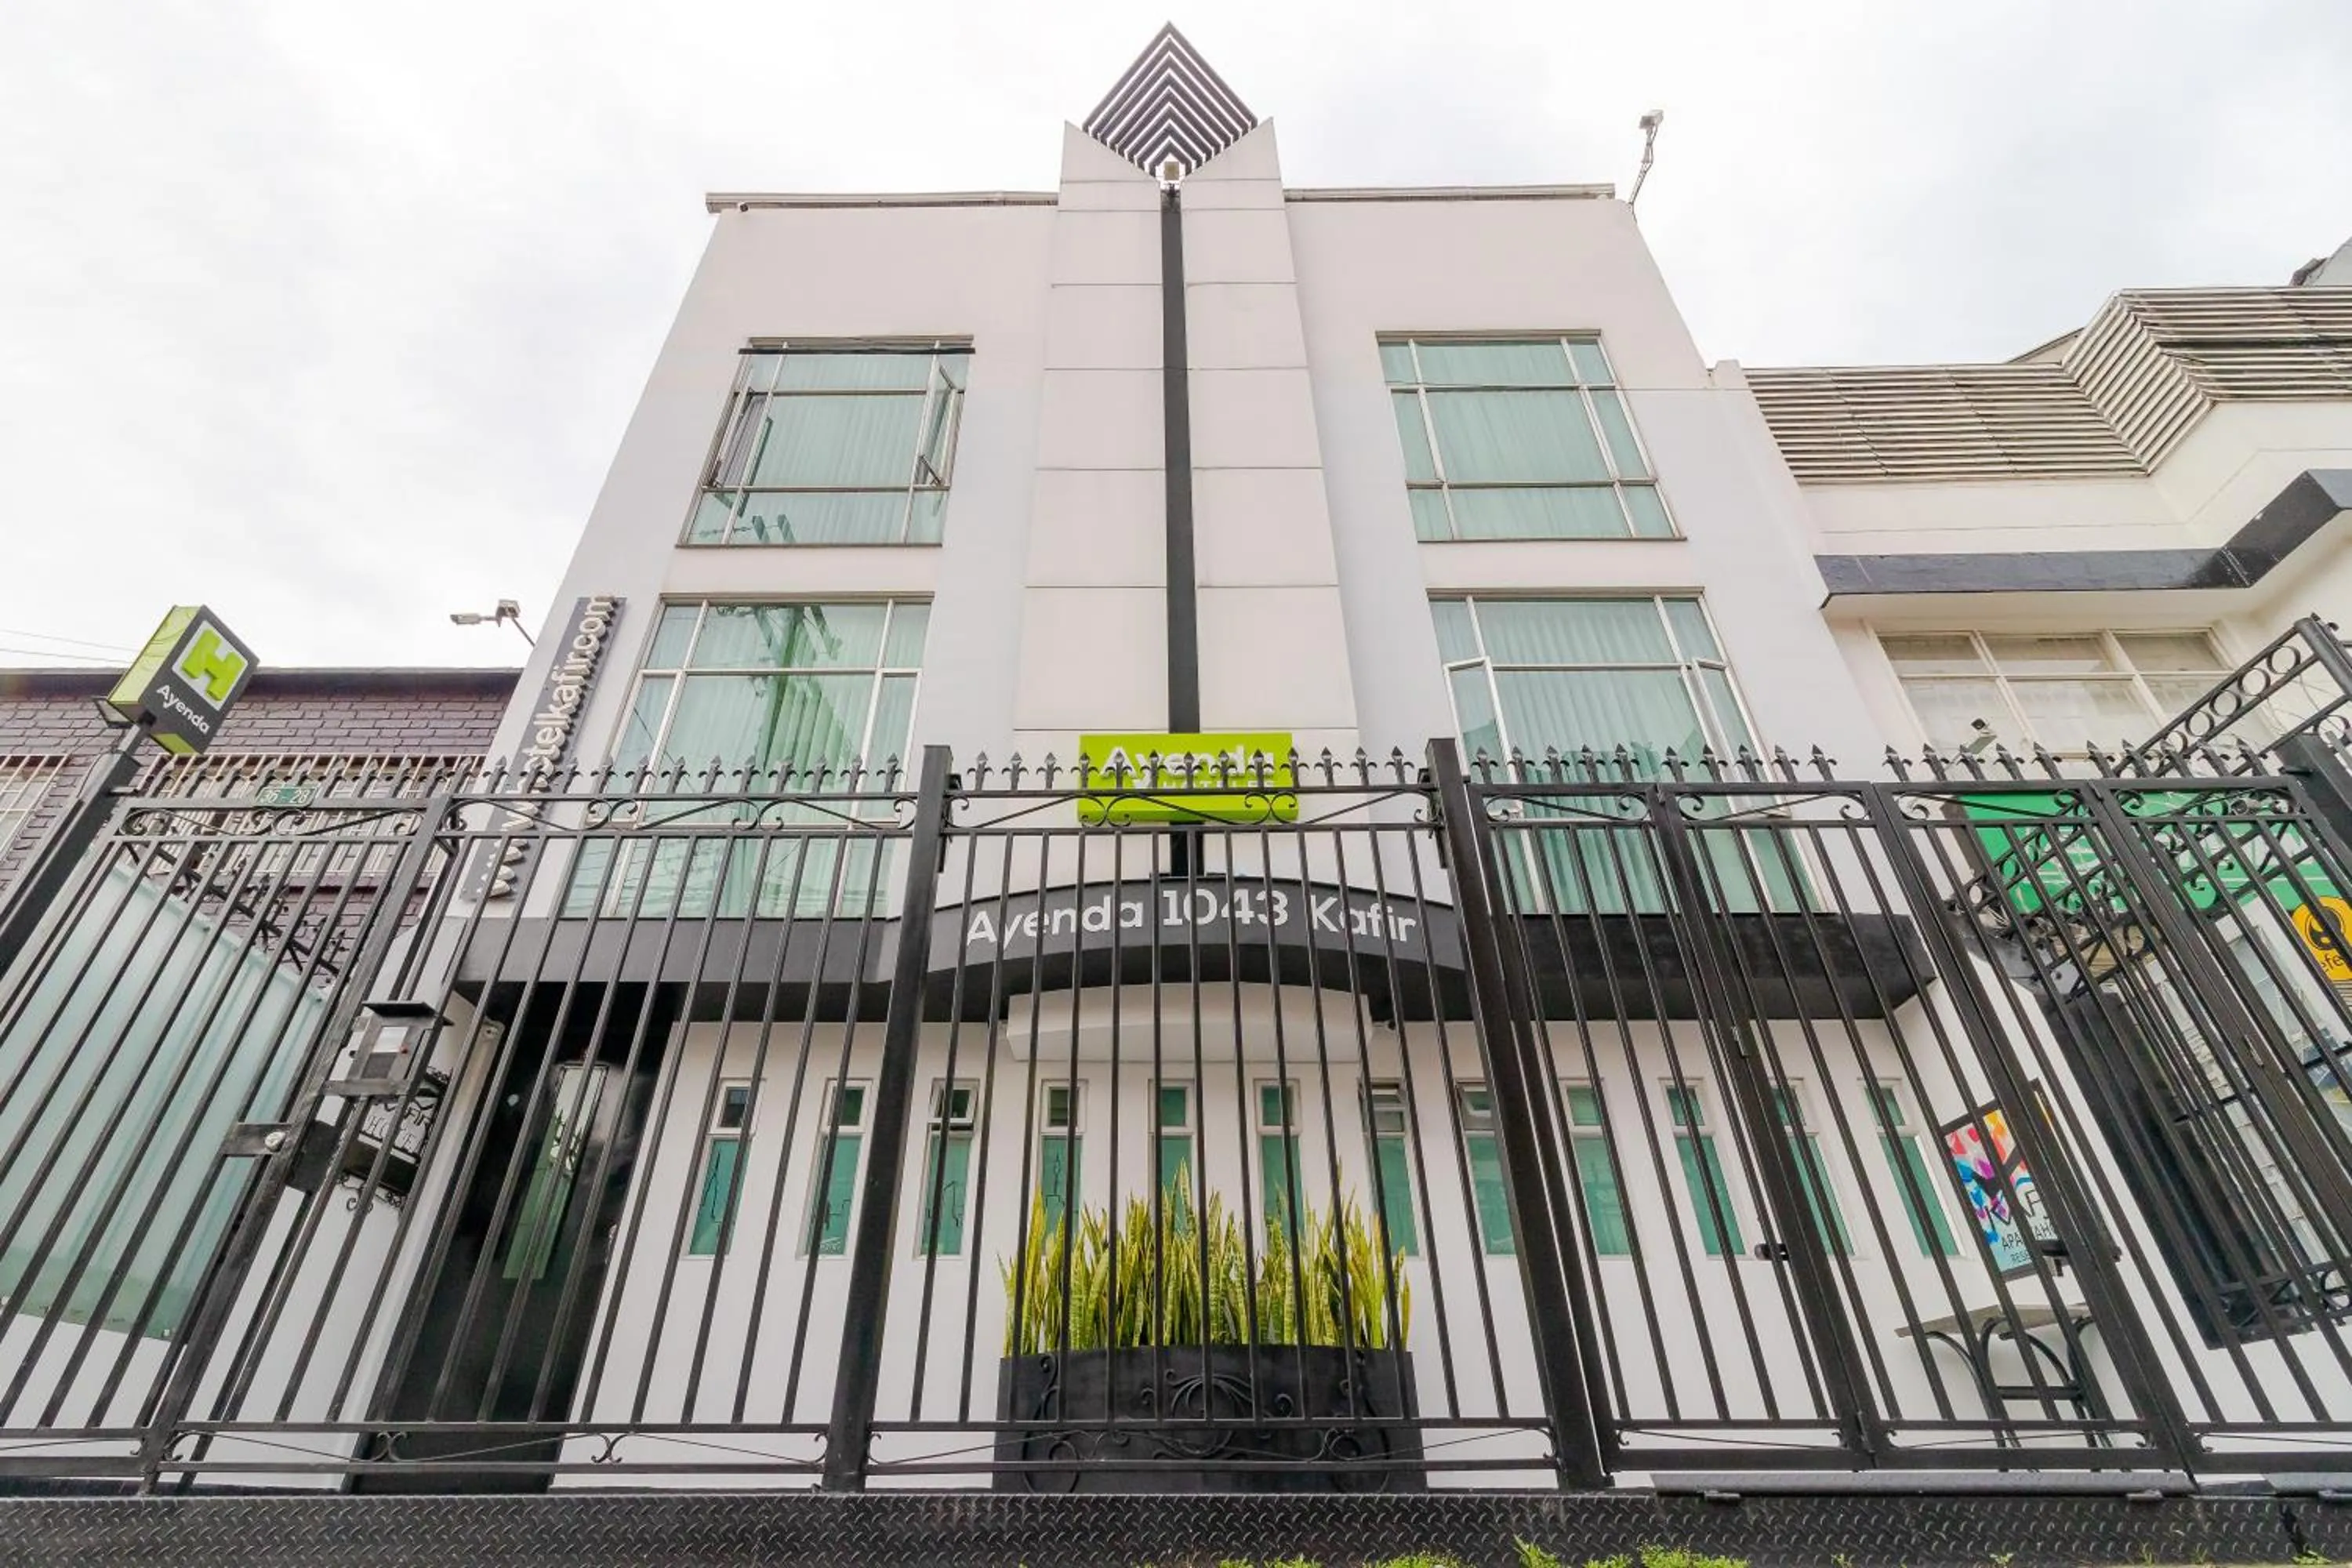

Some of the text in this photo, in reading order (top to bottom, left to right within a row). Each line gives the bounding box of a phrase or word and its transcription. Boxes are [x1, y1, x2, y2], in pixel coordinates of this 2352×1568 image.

[157, 684, 210, 735] Ayenda
[289, 789, 311, 804] 28
[967, 889, 1417, 951] Ayenda 1043 Kafir
